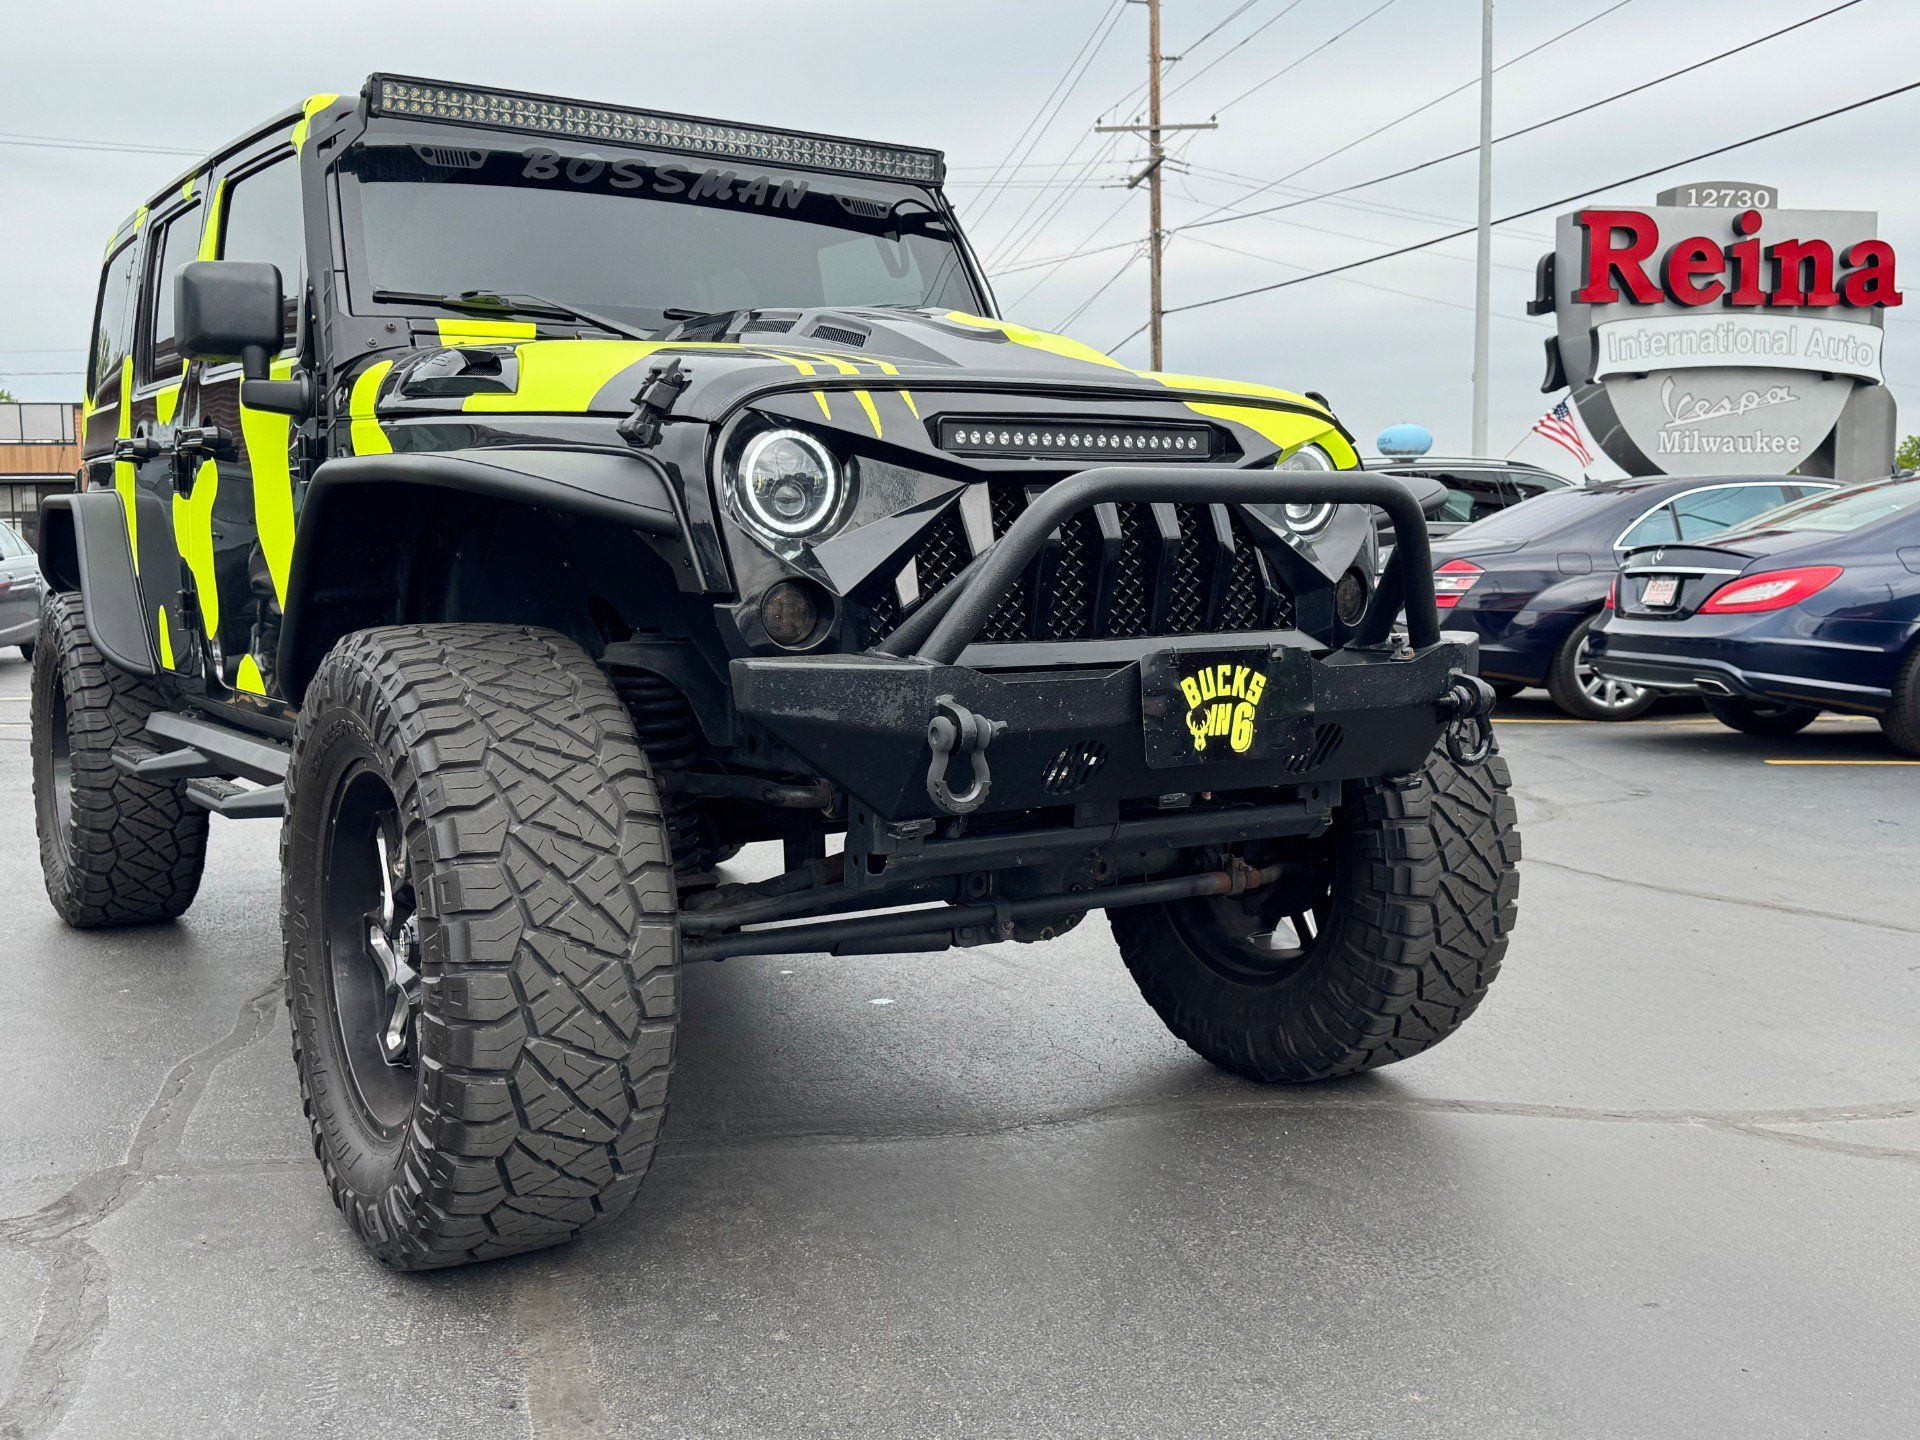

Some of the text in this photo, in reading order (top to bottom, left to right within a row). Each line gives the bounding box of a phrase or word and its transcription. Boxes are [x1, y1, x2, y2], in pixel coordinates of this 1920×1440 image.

[523, 147, 809, 209] BOSSMAN
[1686, 188, 1770, 208] 12730
[1572, 209, 1903, 308] Reina
[1607, 322, 1874, 367] International Auto
[1660, 375, 1801, 428] Vespa
[1657, 430, 1801, 455] Milwaukee
[1181, 665, 1267, 709] BUCKS
[1208, 702, 1255, 752] IN 6
